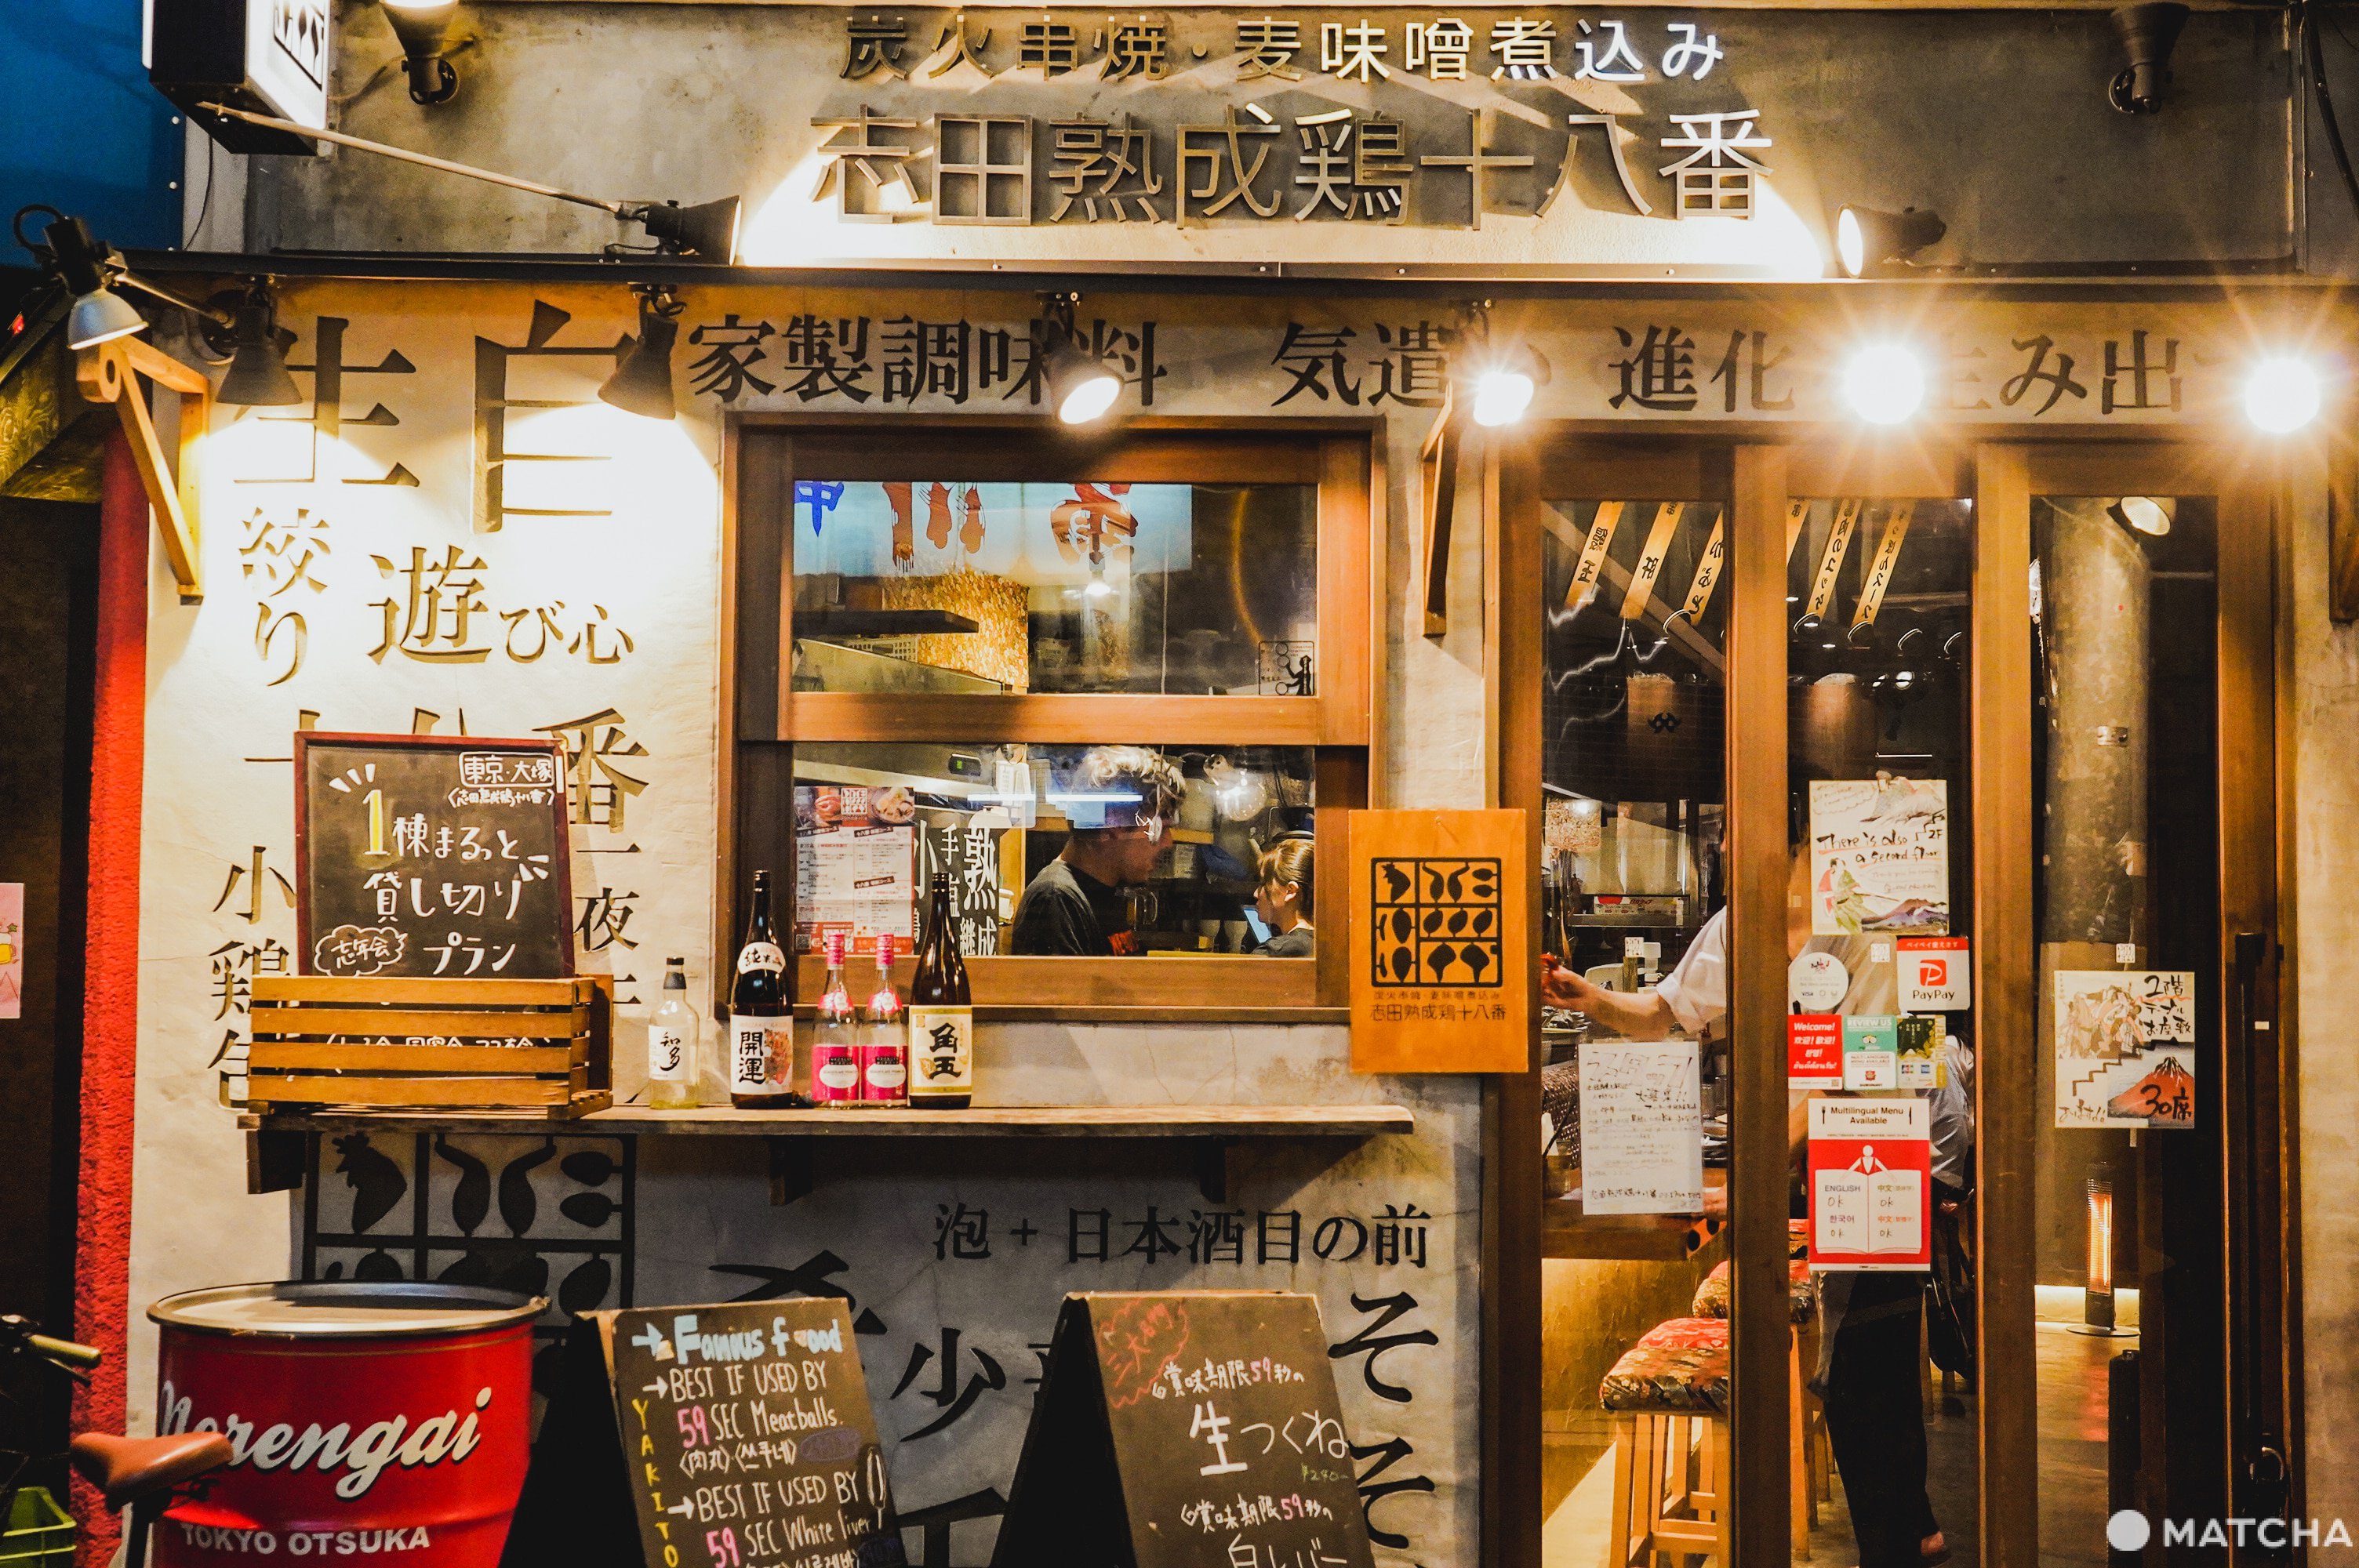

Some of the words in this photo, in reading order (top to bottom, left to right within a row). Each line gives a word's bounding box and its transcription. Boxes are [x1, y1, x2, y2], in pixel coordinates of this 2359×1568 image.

[808, 102, 1774, 230] 志田熟成鶏十八番
[1270, 321, 1552, 408] 気遣
[366, 544, 634, 665] 遊び心
[1816, 833, 1859, 849] There
[1863, 832, 1877, 848] is
[1882, 829, 1908, 846] also
[363, 871, 522, 924] 貸し切り
[423, 931, 517, 976] プラン
[1913, 989, 1955, 1001] PayPay
[929, 1022, 962, 1081] 角玉
[1794, 1022, 1836, 1031] Welcome!
[739, 1031, 766, 1085] 開運
[1830, 1106, 1877, 1116] Multilingual
[674, 1314, 765, 1365] Famous
[669, 1367, 714, 1403] BEST
[725, 1364, 745, 1396] IF
[754, 1361, 798, 1396] USED
[801, 1359, 827, 1391] BY
[677, 1404, 711, 1449] 59
[711, 1403, 746, 1441] SEC
[1189, 1400, 1350, 1478] 生つくね
[695, 1483, 747, 1523] BEST
[751, 1481, 772, 1515] IF
[776, 1475, 827, 1508] USED
[833, 1470, 860, 1505] BY
[180, 1522, 277, 1554] TOKYO
[288, 1525, 431, 1556] OTSUKA
[706, 1526, 741, 1568] 59
[744, 1519, 782, 1557] SEC
[782, 1514, 834, 1551] White
